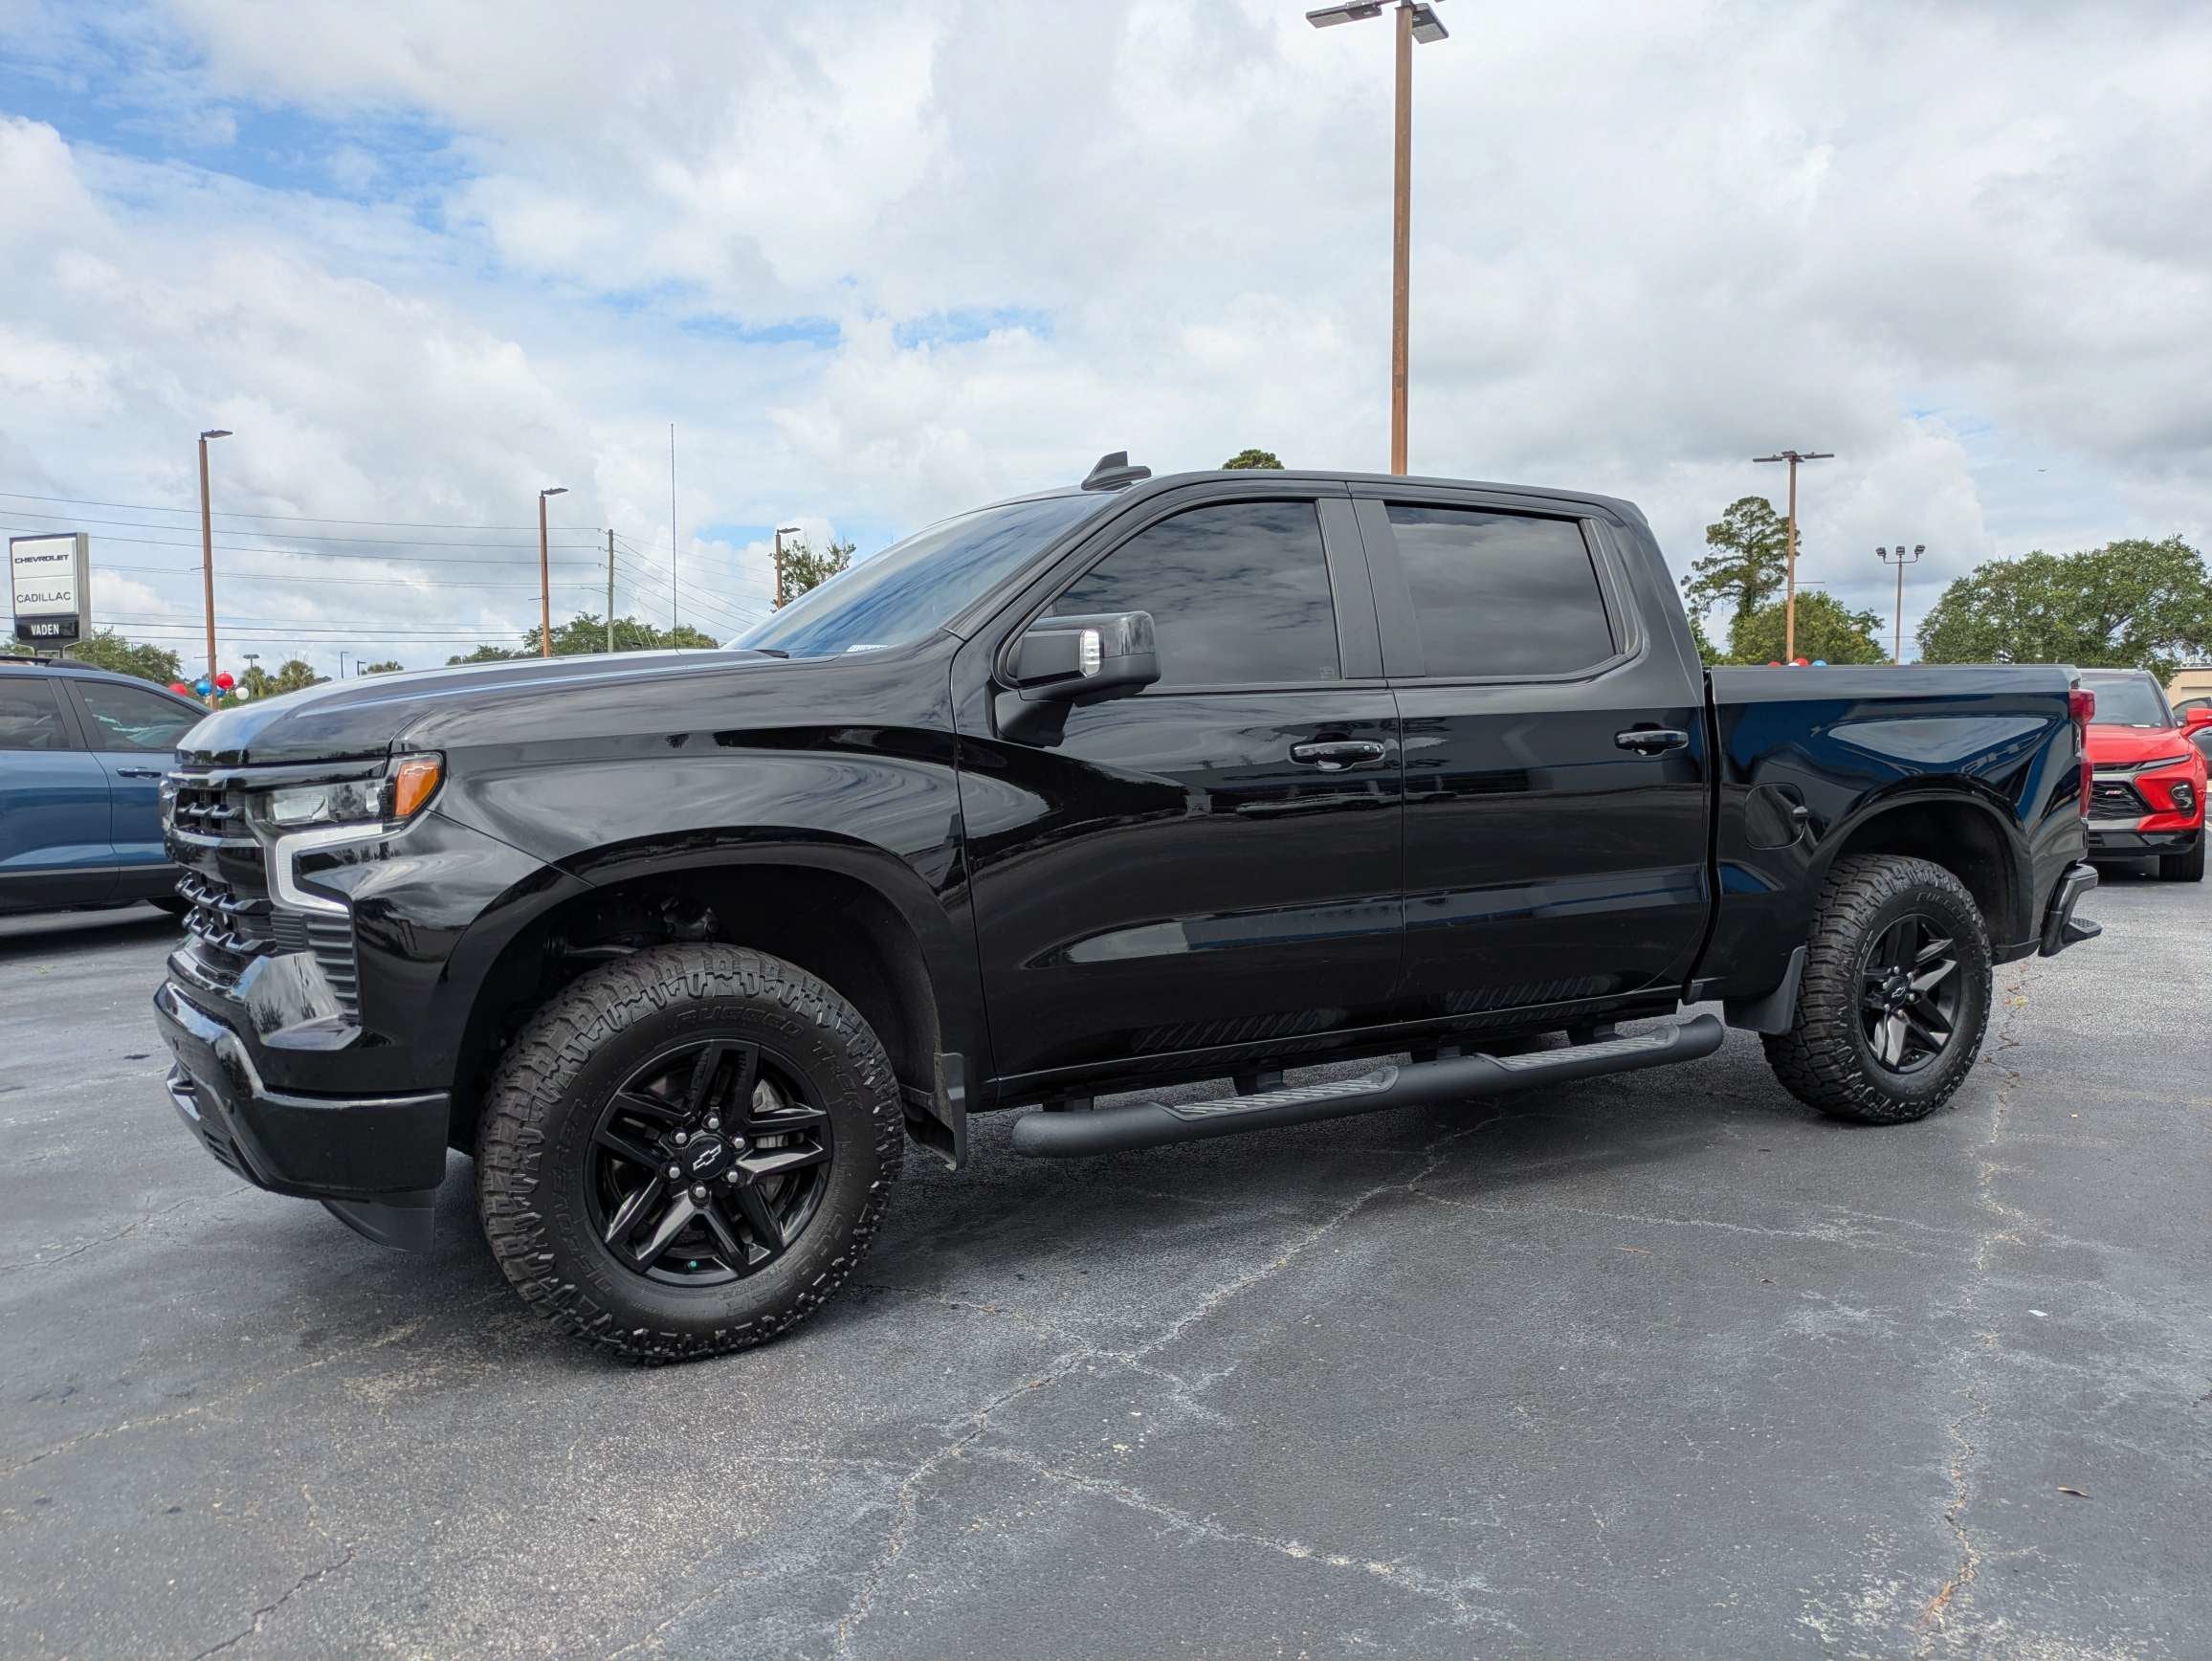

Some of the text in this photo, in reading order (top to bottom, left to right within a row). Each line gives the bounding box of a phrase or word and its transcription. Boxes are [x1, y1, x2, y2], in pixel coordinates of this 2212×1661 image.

[14, 554, 69, 564] CHEVROLET
[16, 591, 72, 604] CADILLAC
[31, 624, 59, 635] VADEN
